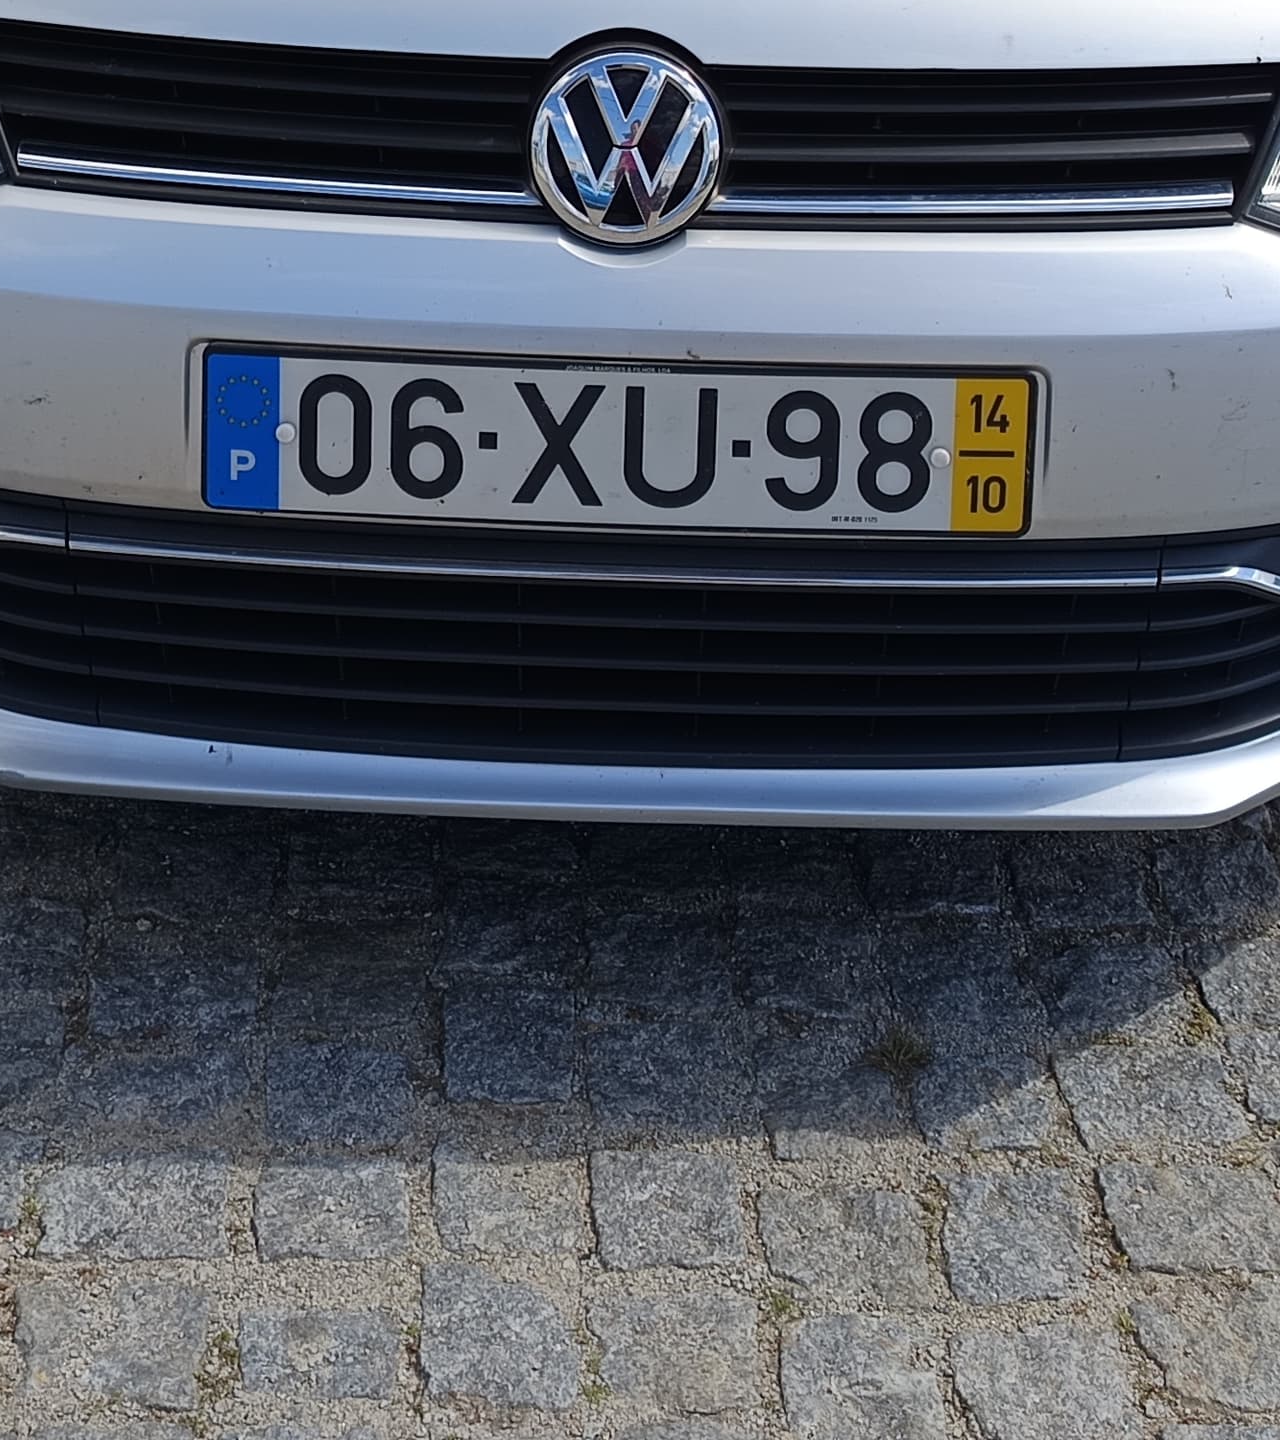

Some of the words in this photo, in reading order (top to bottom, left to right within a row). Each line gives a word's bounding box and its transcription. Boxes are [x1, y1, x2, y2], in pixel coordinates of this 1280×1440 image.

[969, 394, 1010, 433] 14
[230, 449, 256, 481] P
[966, 475, 1007, 514] 10
